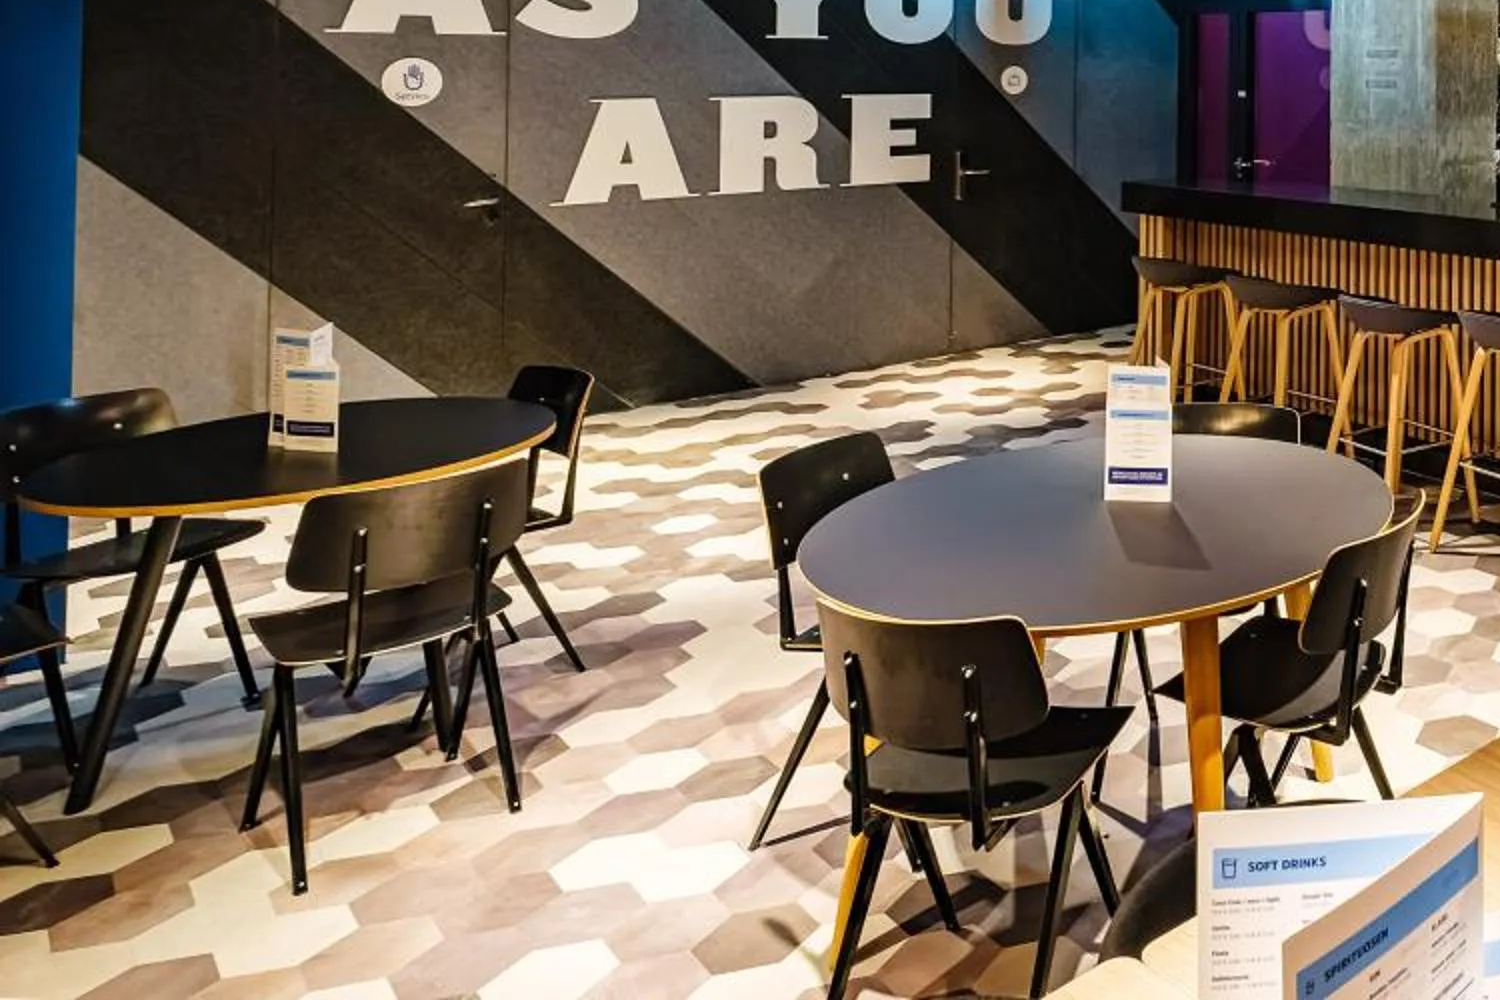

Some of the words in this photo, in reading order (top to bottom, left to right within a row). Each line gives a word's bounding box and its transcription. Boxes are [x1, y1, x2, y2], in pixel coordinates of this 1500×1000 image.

[549, 93, 932, 206] ARE
[1247, 859, 1279, 873] SOFT
[1281, 856, 1327, 871] DRINKS
[1323, 926, 1390, 983] SPIRITUOSEN
